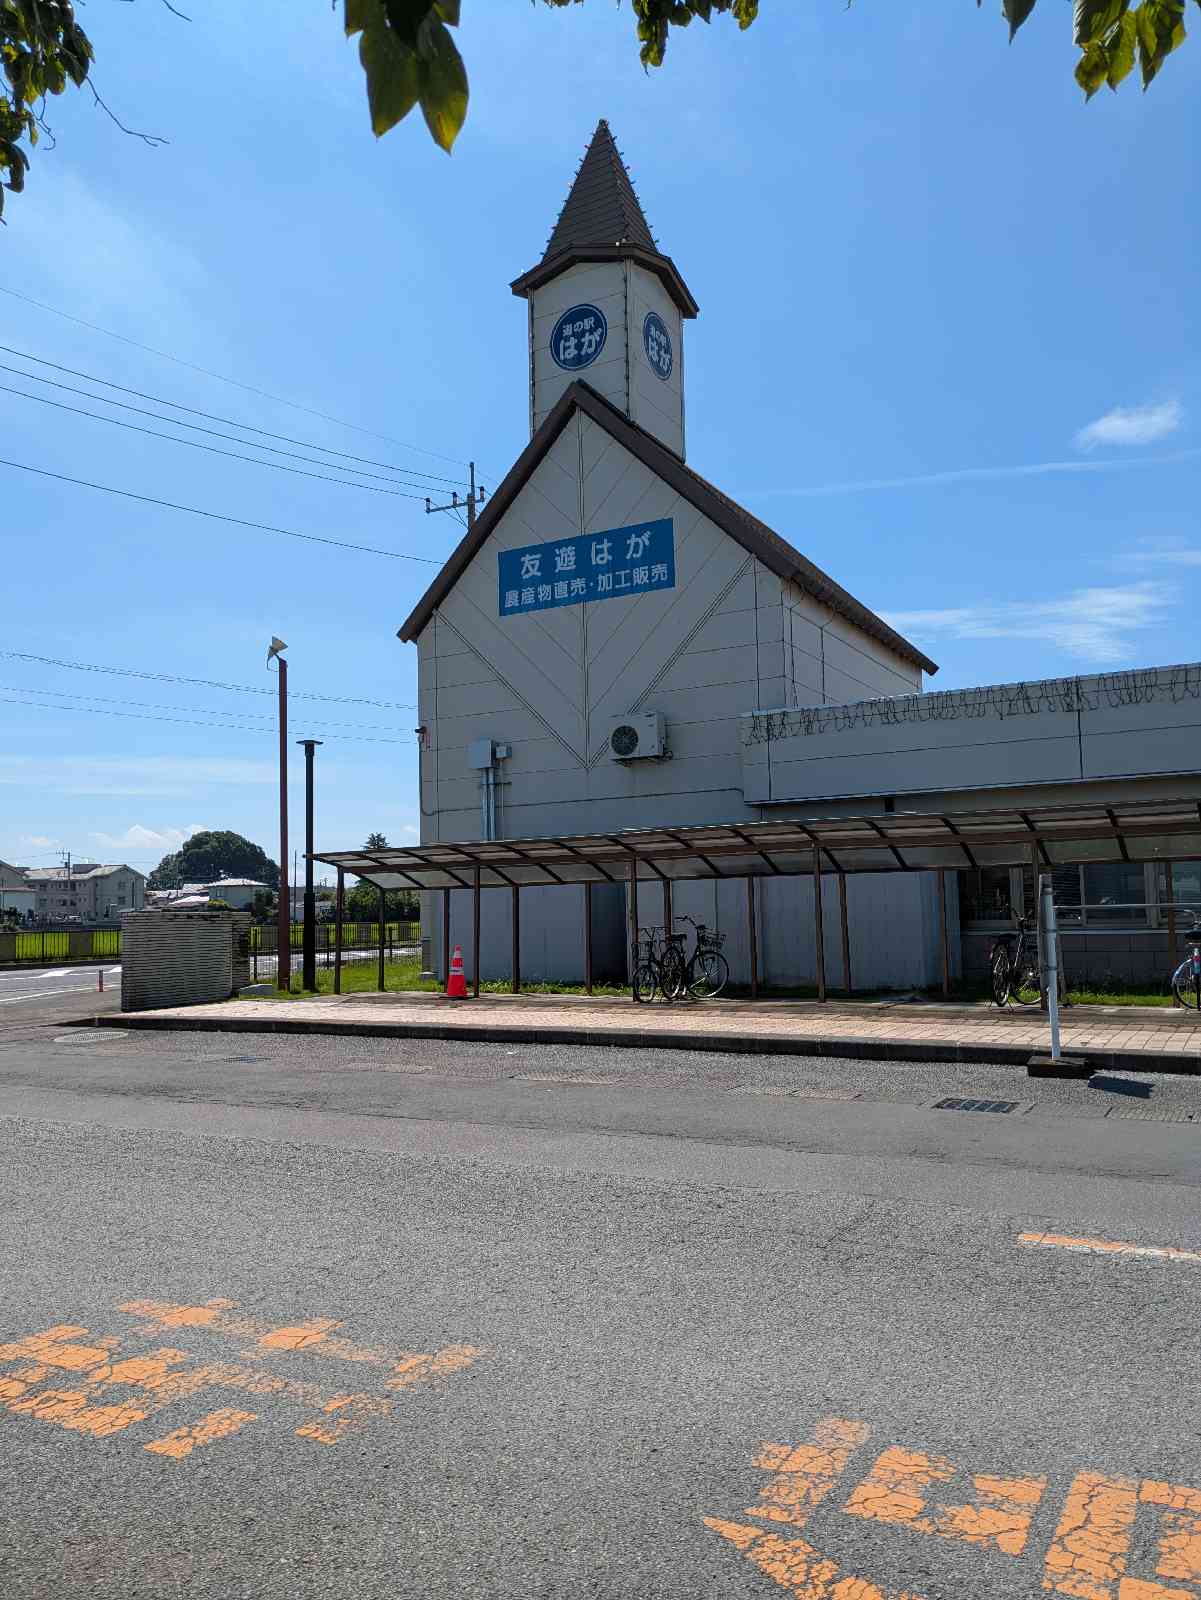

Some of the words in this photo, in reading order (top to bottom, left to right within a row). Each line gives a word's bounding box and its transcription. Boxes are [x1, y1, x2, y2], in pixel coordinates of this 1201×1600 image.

[562, 317, 595, 337] 道の駅
[560, 328, 602, 360] はが
[648, 336, 670, 372] はが
